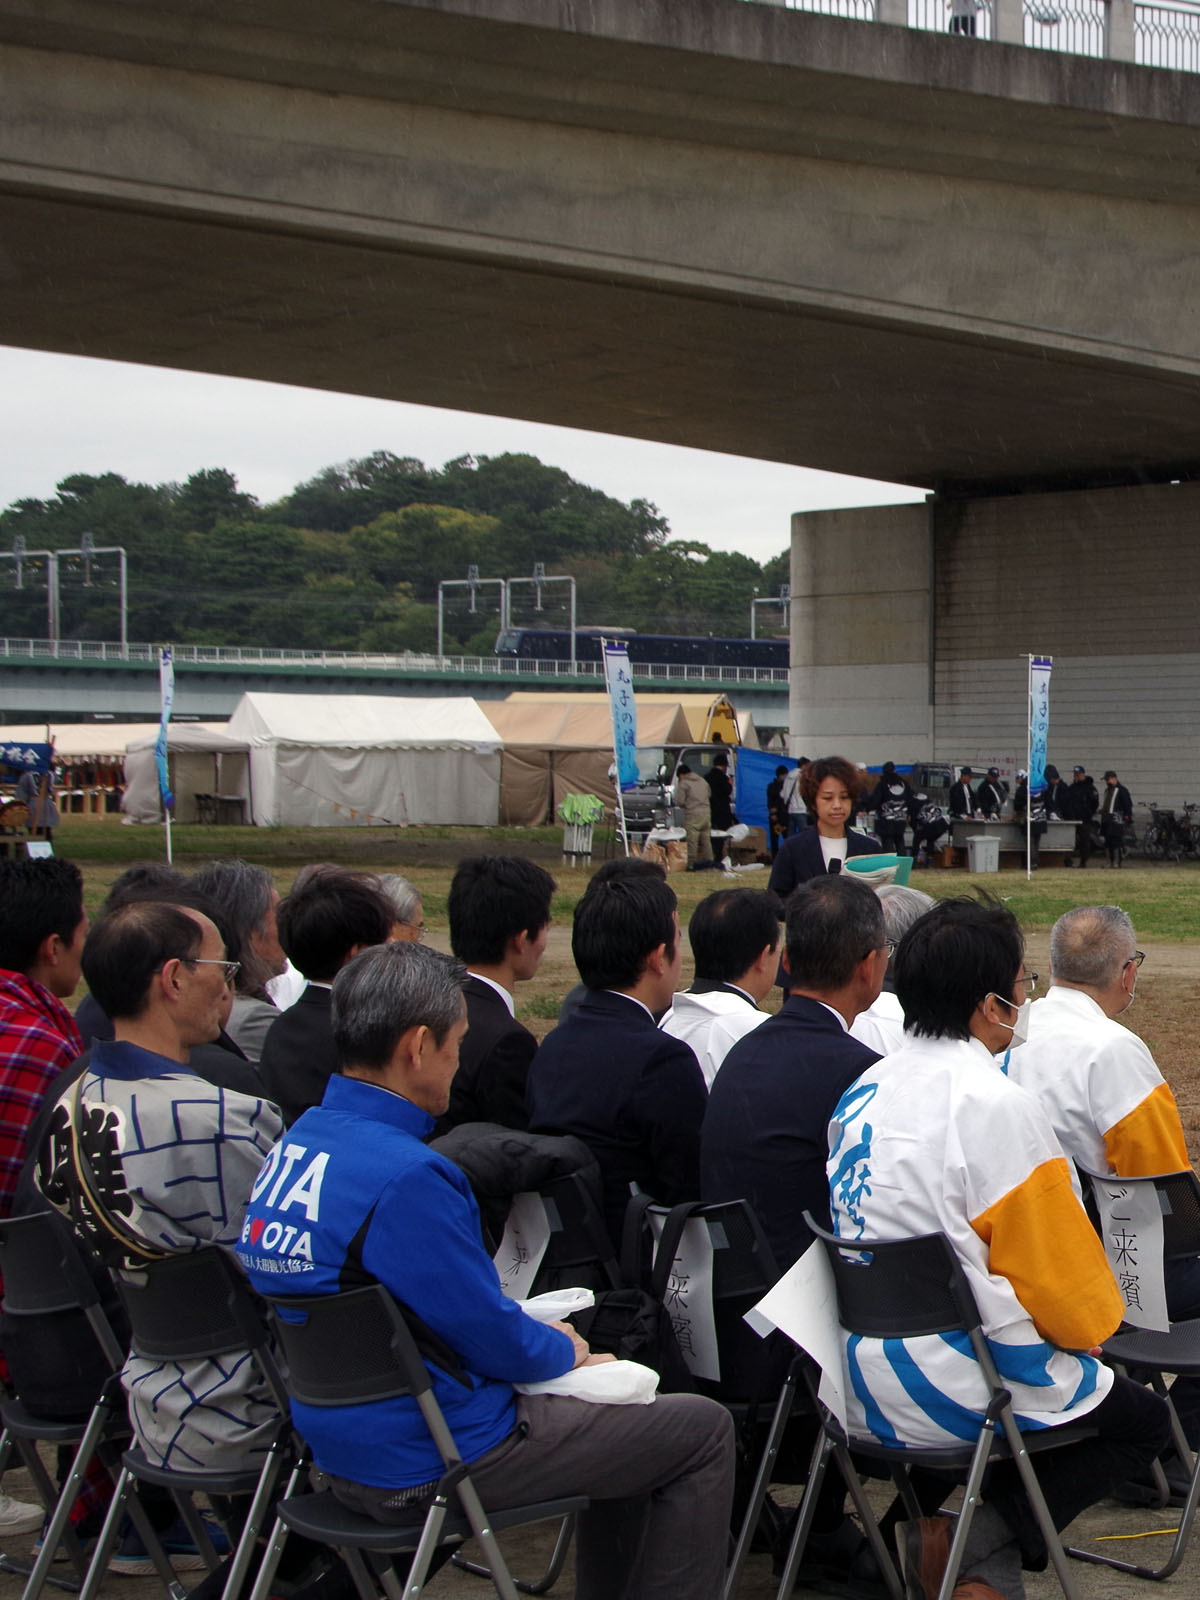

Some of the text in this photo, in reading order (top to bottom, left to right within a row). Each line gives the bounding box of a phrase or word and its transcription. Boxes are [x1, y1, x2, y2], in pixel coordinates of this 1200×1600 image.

[261, 1222, 313, 1261] OTA
[1107, 1186, 1144, 1312] ご来賓
